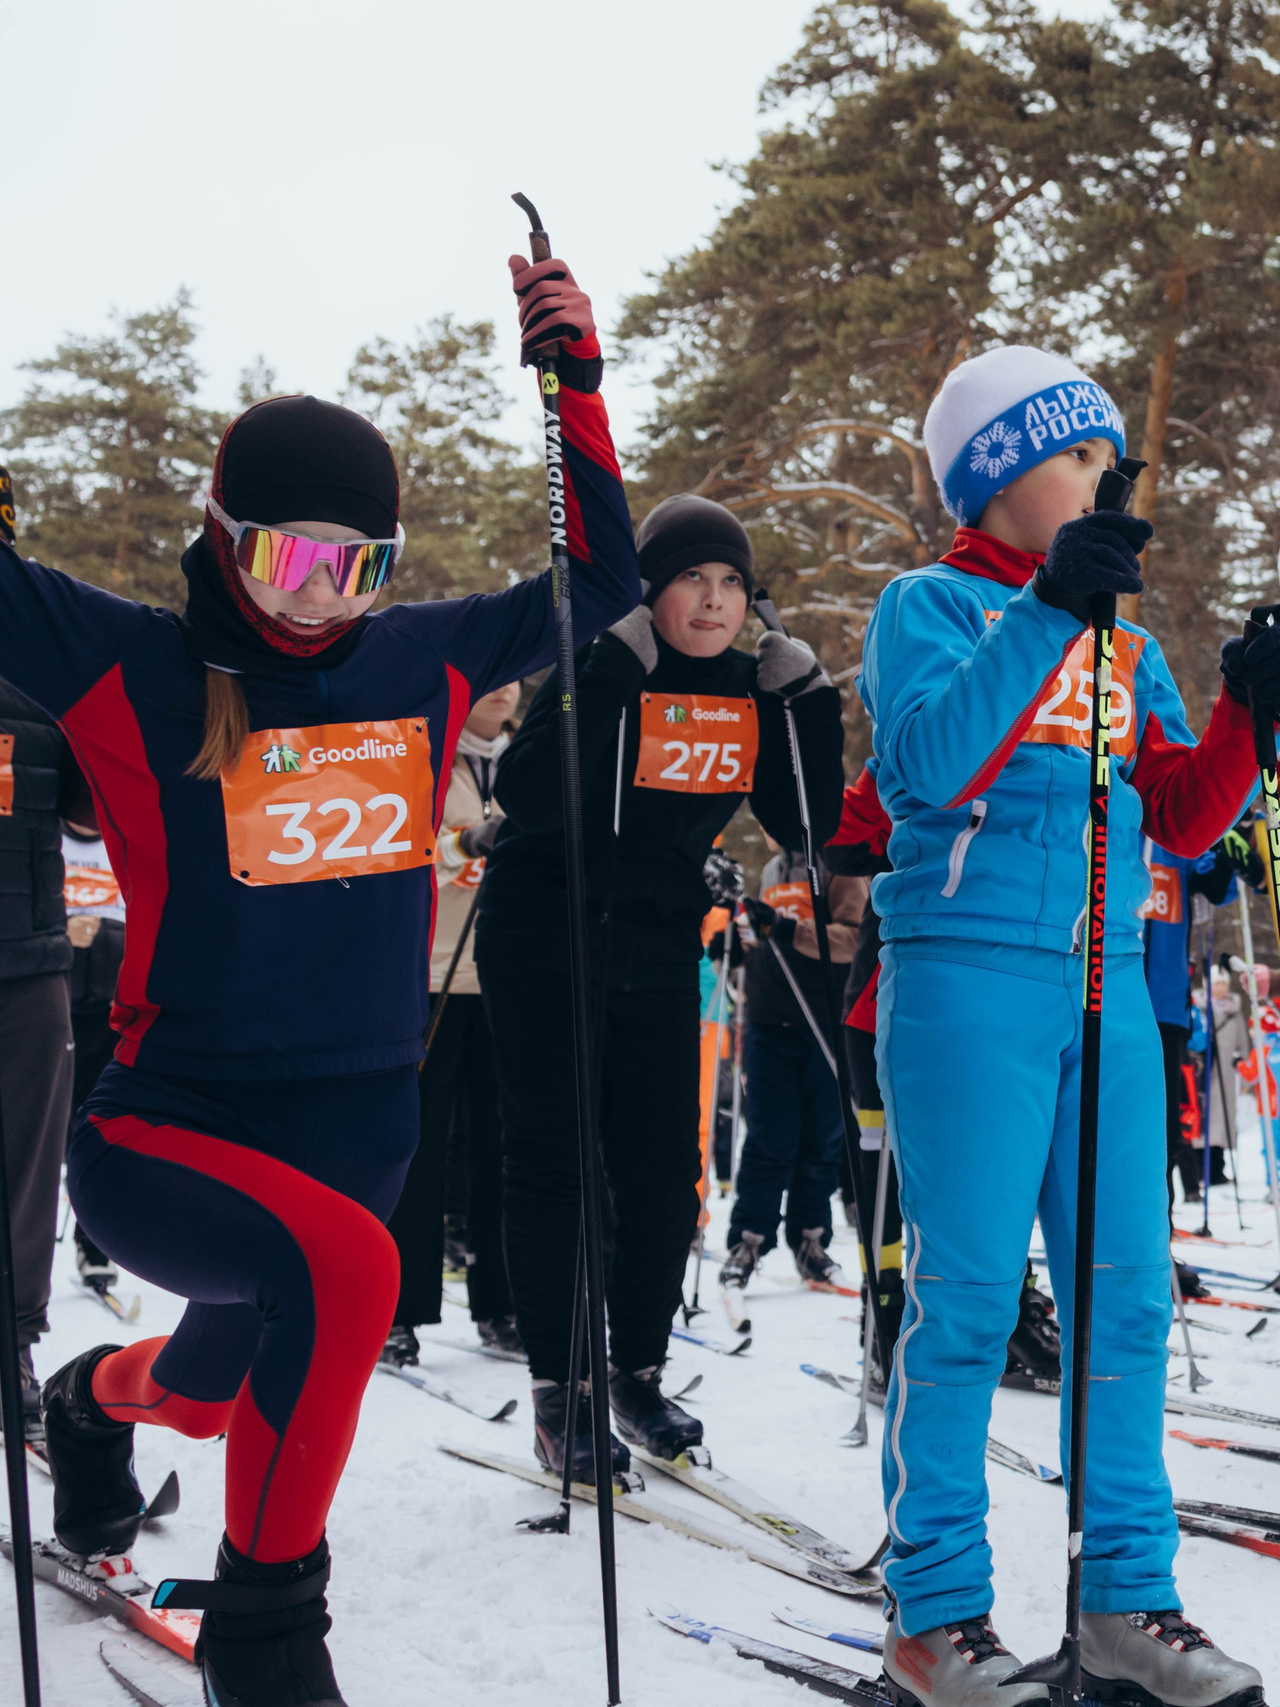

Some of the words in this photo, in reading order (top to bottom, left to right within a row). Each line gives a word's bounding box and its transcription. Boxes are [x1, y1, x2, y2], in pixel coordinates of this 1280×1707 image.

[545, 407, 567, 546] NORDWAY
[562, 694, 572, 712] RS
[691, 707, 740, 723] Goodline
[1033, 668, 1132, 738] 259
[308, 738, 407, 764] Goodline
[659, 741, 741, 782] 275
[265, 793, 412, 865] 322
[57, 1568, 98, 1601] MADSHUS
